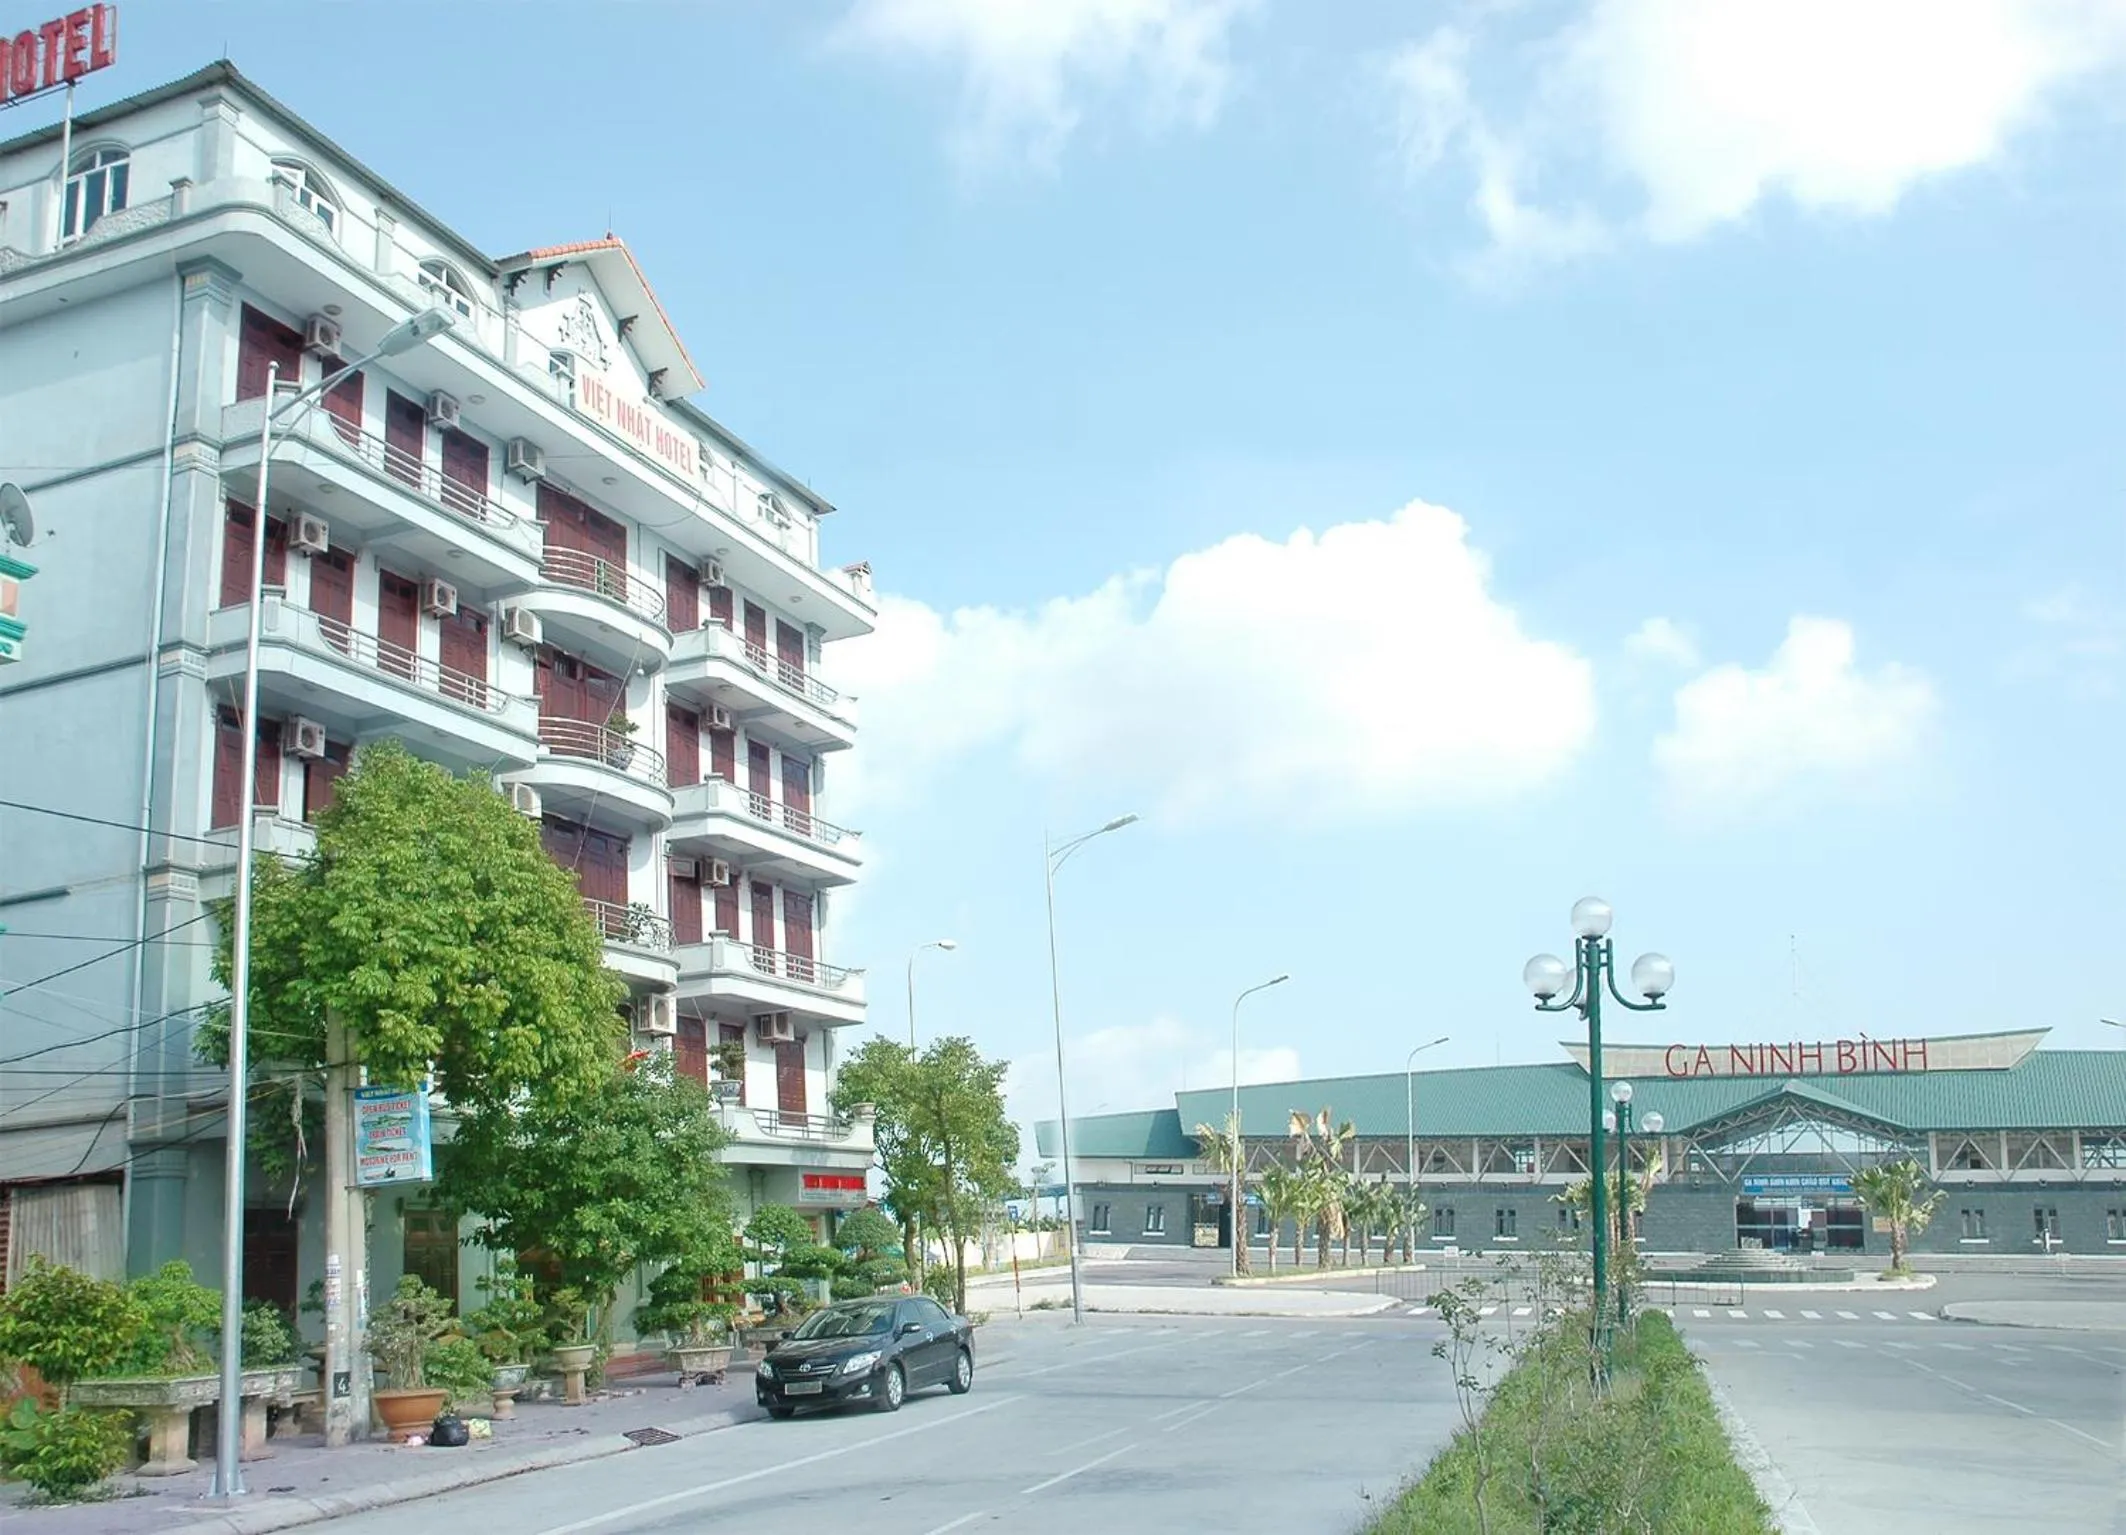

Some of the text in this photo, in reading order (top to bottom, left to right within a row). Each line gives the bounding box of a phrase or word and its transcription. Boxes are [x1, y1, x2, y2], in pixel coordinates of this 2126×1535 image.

[582, 373, 612, 420] VIỆT
[656, 425, 694, 475] HOTEL
[1665, 1032, 1927, 1077] GA NINH BÌNH
